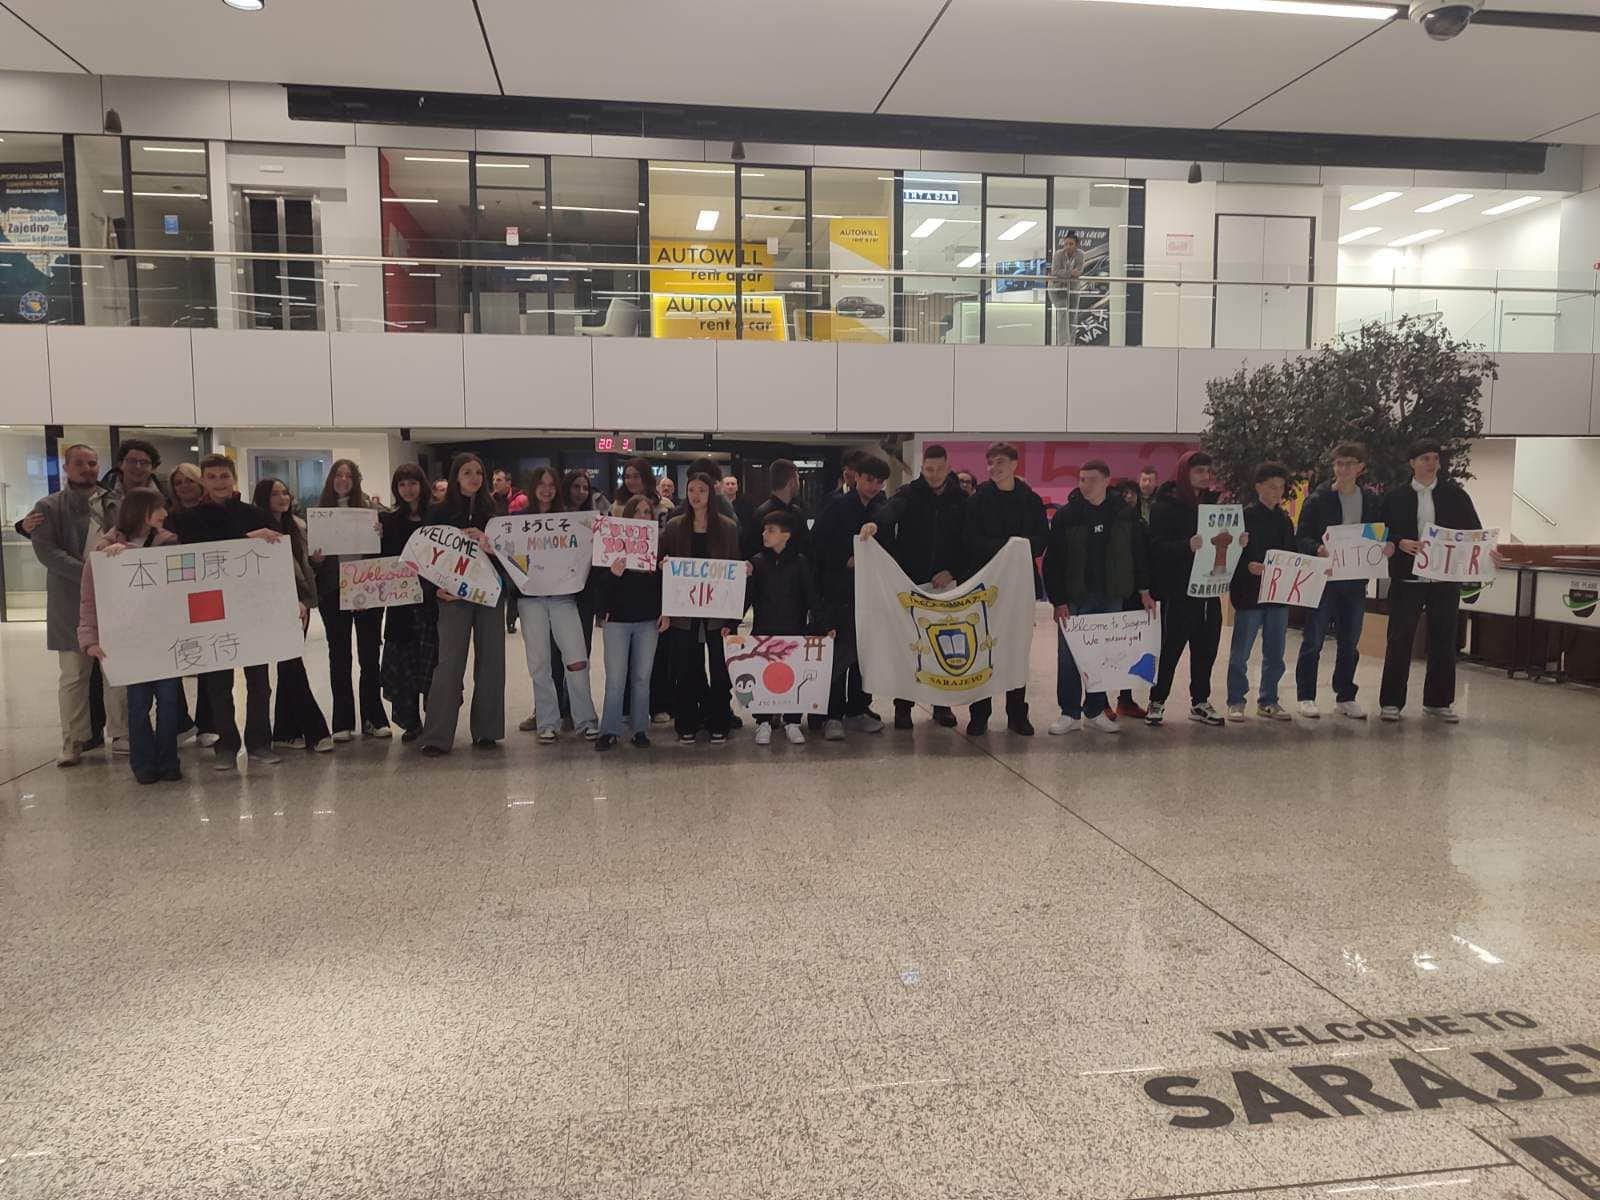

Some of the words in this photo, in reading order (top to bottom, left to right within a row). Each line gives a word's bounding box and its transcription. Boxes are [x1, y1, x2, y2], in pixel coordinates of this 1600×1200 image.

[8, 223, 49, 234] Zajedno
[840, 229, 879, 237] AUTOWILL
[657, 247, 763, 265] AUTOWLL
[700, 319, 730, 331] rent
[748, 320, 771, 331] car
[521, 518, 571, 533] ようこそ
[418, 525, 480, 559] WELCOME
[527, 534, 578, 550] MOMOKA
[671, 560, 738, 581] WELCOME
[1066, 616, 1109, 633] Welcome
[929, 674, 984, 687] SARAJEVO
[1214, 1014, 1473, 1050] WELCOME
[1461, 1010, 1538, 1031] TO
